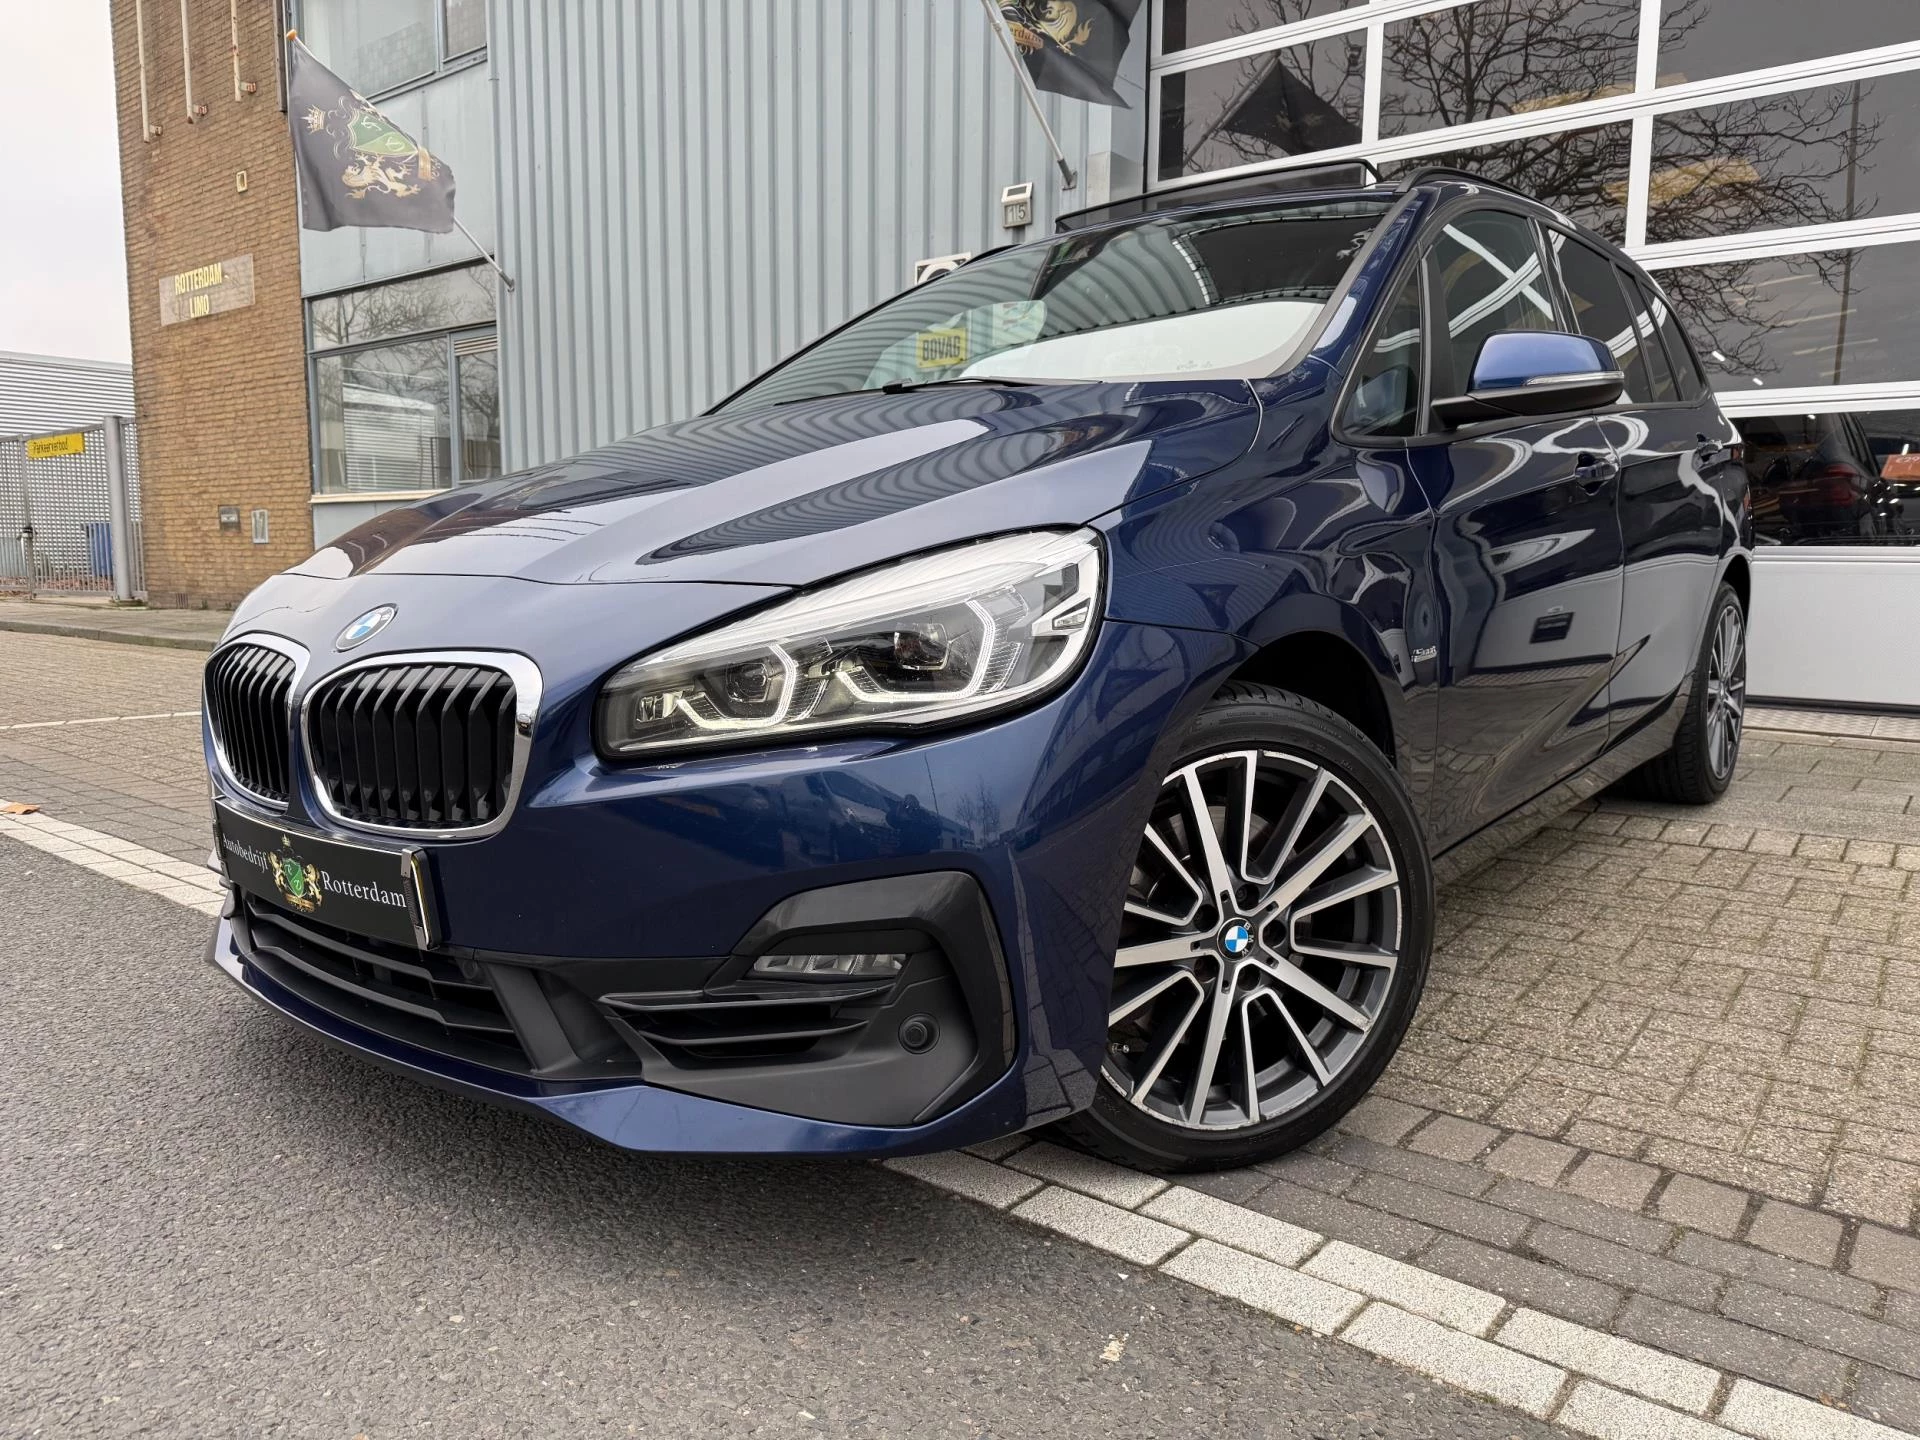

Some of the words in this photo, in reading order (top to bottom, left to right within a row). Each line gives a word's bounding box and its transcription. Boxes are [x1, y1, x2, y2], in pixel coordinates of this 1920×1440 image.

[1008, 204, 1025, 222] 15
[174, 262, 222, 296] ROTTERDAM
[189, 294, 210, 318] LIMO
[922, 335, 961, 361] BOVAG
[222, 833, 268, 873] Autobedrijf
[321, 870, 407, 908] Rotterdam
